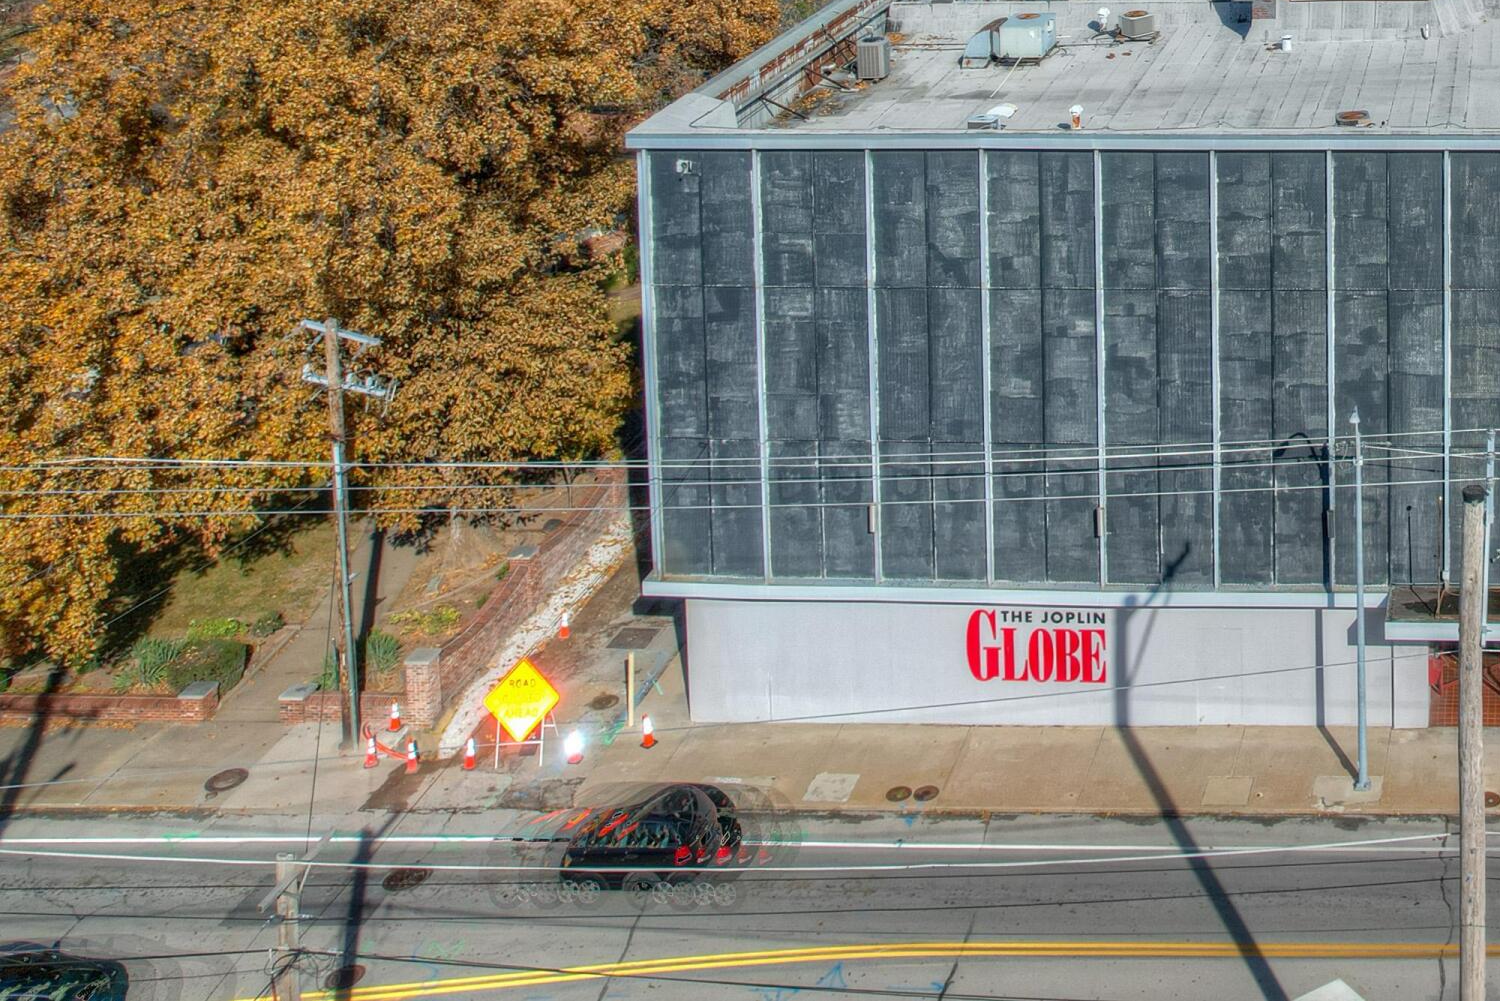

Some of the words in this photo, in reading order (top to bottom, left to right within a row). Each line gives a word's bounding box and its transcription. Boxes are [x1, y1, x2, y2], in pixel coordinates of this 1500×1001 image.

[1001, 610, 1032, 623] THE
[1041, 611, 1106, 624] JOPLIN
[966, 609, 1106, 683] GLOBE
[509, 678, 537, 689] ROAD
